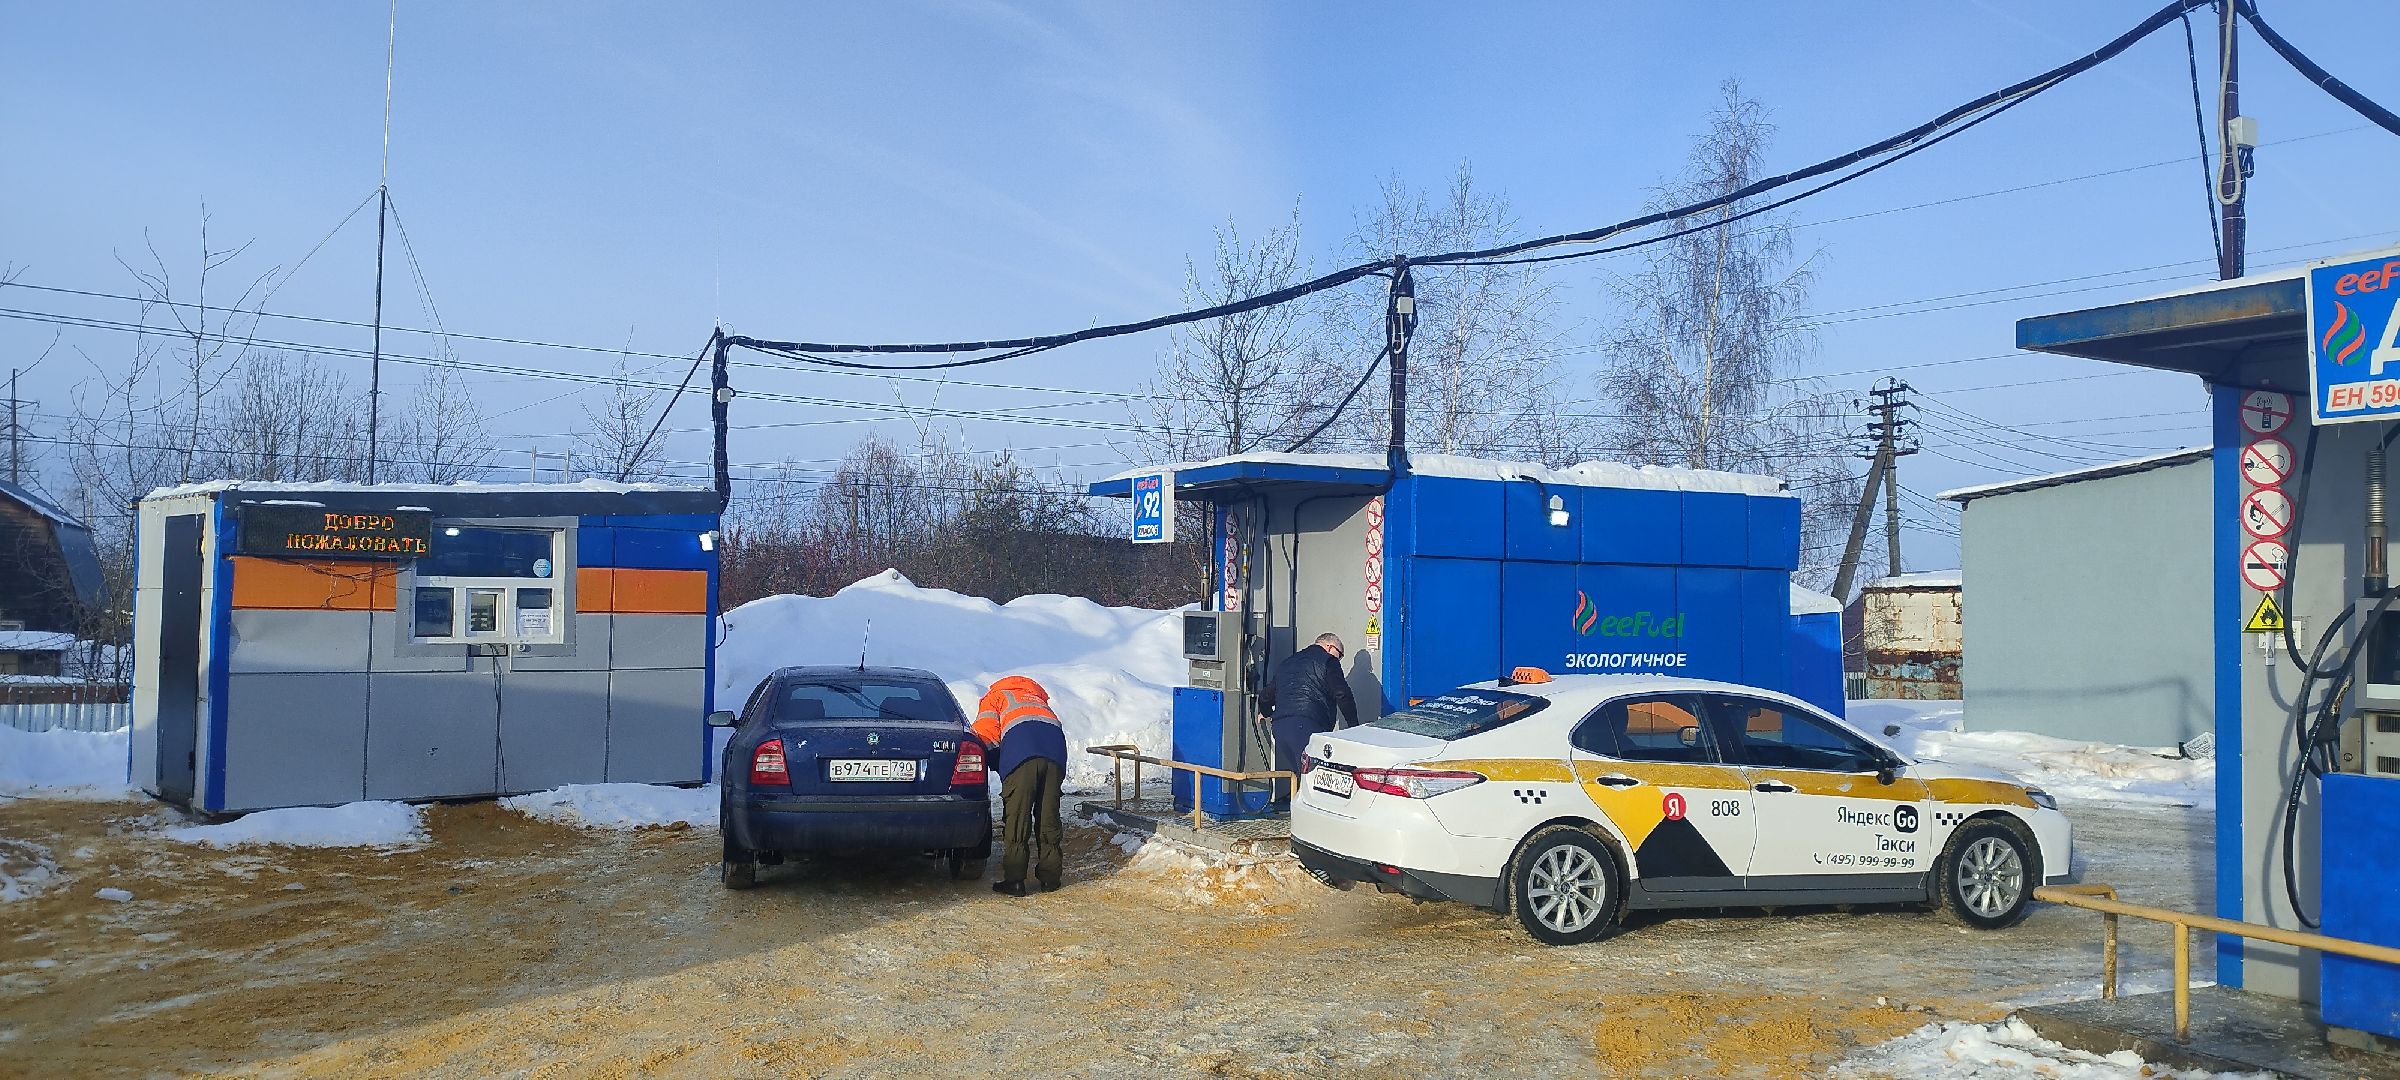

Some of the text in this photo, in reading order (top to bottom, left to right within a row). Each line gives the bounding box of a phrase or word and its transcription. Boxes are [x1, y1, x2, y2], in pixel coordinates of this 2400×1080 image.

[1143, 490, 1160, 519] 92
[323, 513, 395, 532] ДОБРО
[285, 533, 427, 554] ПОЖАЛОВАТЬ
[1600, 611, 1686, 638] eeFuel
[1565, 653, 1688, 669] ЭКОЛОГИЧНОЕ
[1668, 798, 1680, 817] Я
[1711, 800, 1741, 817] 808
[1837, 806, 1917, 829] Яндекс Go
[1875, 833, 1915, 852] Такси
[1826, 852, 1915, 869] (495) 999-99-99
